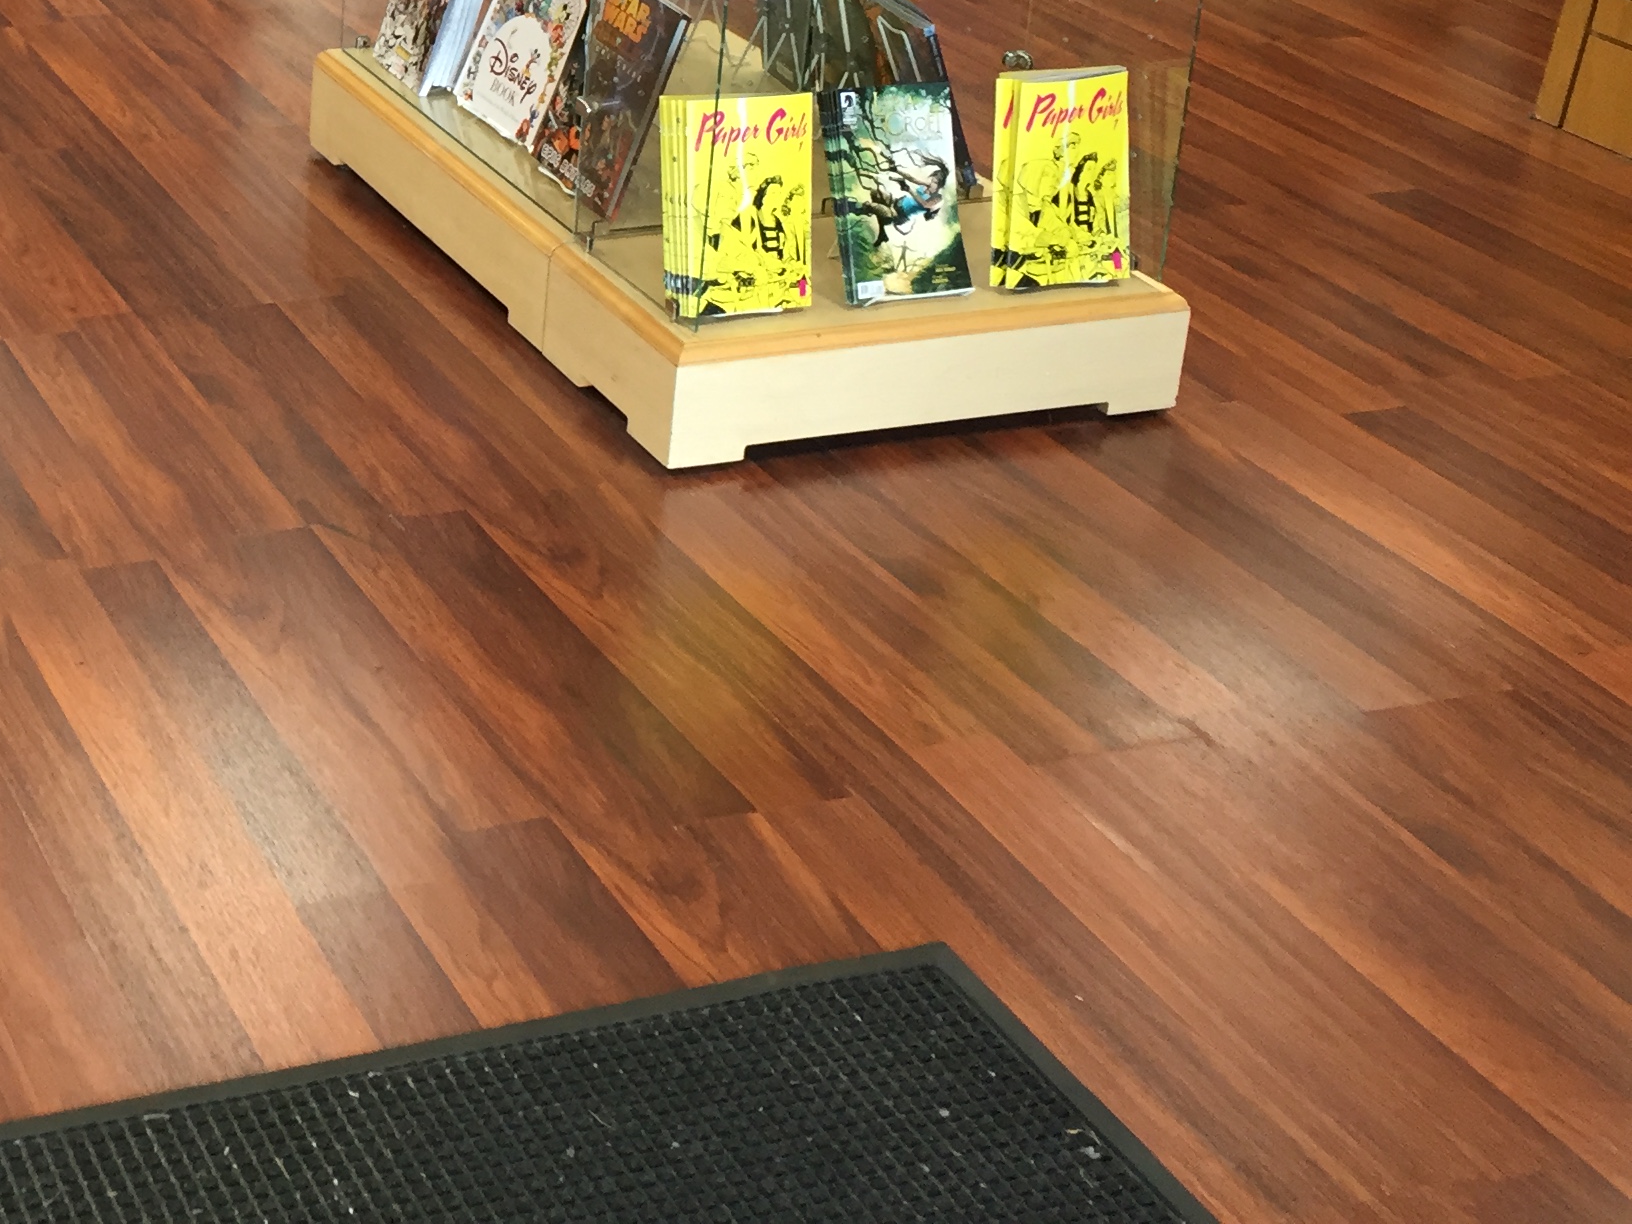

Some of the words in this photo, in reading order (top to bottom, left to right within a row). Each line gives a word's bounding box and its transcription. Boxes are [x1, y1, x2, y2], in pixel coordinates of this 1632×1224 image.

[602, 5, 650, 43] WARS
[694, 110, 761, 158] Paper
[765, 107, 808, 145] Girls
[1026, 91, 1084, 138] Paper
[1088, 87, 1124, 124] Girls
